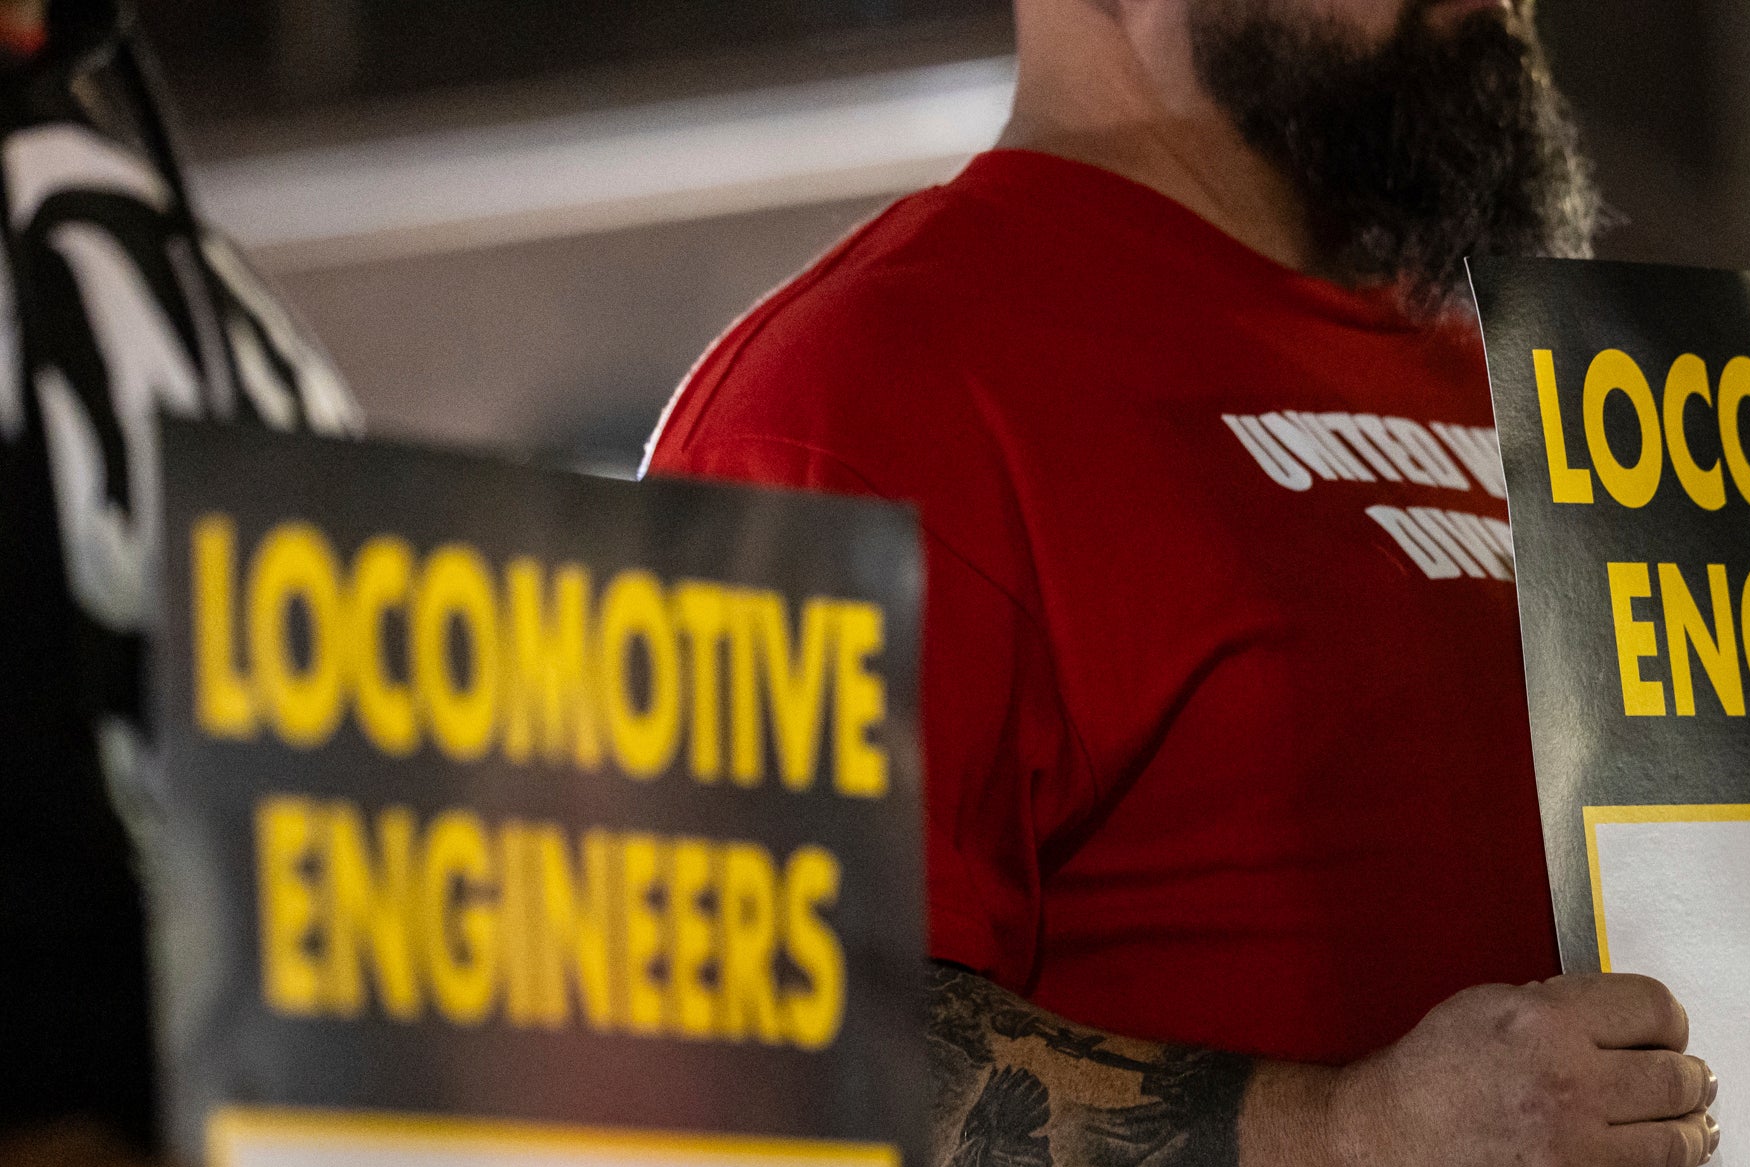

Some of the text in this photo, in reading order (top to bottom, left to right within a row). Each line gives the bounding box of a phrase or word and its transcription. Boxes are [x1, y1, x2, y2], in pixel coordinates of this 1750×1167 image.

[1222, 411, 1472, 492] UNITED
[194, 515, 889, 796] LOCOMOTIVE
[257, 798, 845, 1049] ENGINEERS
